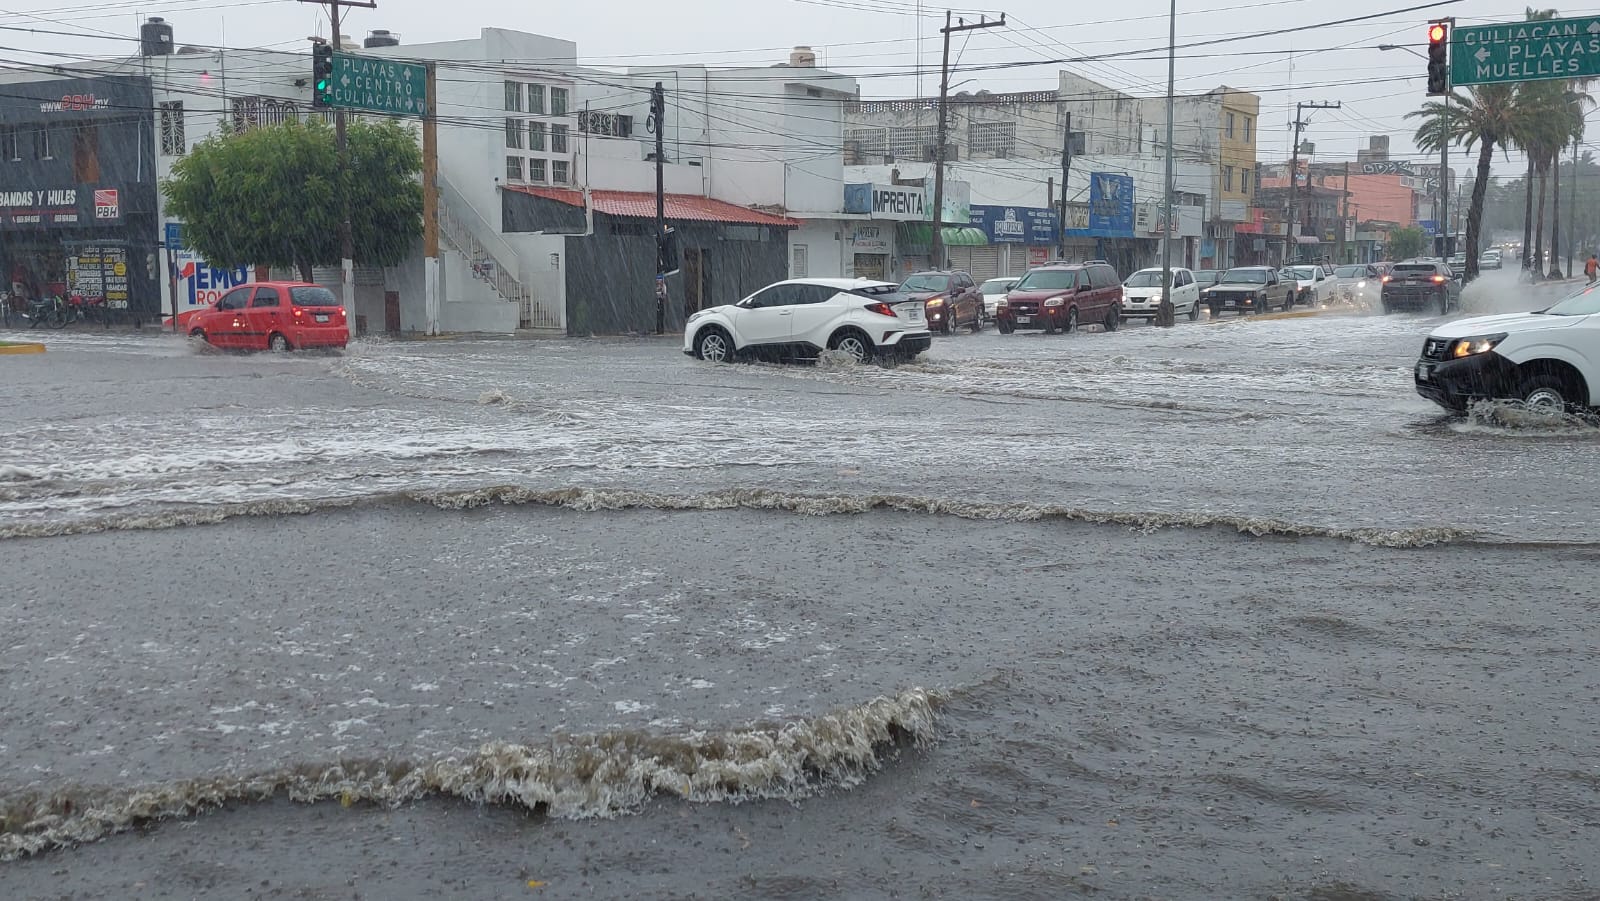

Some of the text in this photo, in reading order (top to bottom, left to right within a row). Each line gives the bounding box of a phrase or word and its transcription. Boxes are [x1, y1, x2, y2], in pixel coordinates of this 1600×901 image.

[1464, 24, 1577, 46] CULIACAN
[1509, 39, 1600, 59] PLAYAS
[343, 59, 395, 78] PLAYAS
[1477, 58, 1580, 79] MUELLES
[355, 76, 412, 95] CENTRO
[335, 88, 402, 108] CULIACAN
[37, 190, 44, 205] Y
[48, 189, 76, 205] HULES
[872, 190, 923, 214] IMPRENTA
[97, 207, 117, 216] PBH
